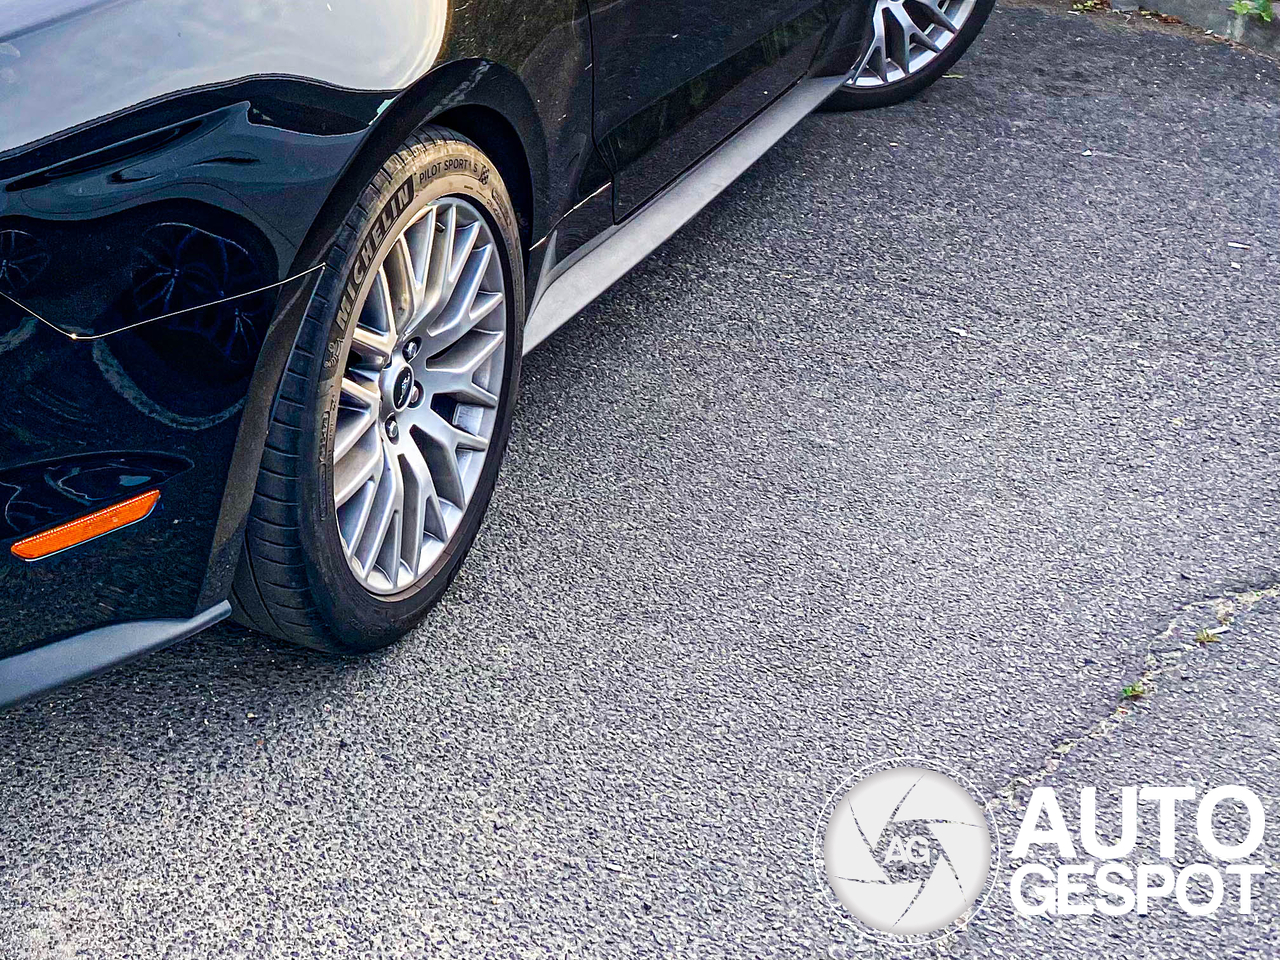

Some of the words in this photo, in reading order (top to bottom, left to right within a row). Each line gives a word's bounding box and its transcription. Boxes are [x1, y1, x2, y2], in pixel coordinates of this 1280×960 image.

[420, 162, 441, 182] PILOT
[444, 158, 468, 171] SPORT
[334, 181, 412, 331] MICHELIN
